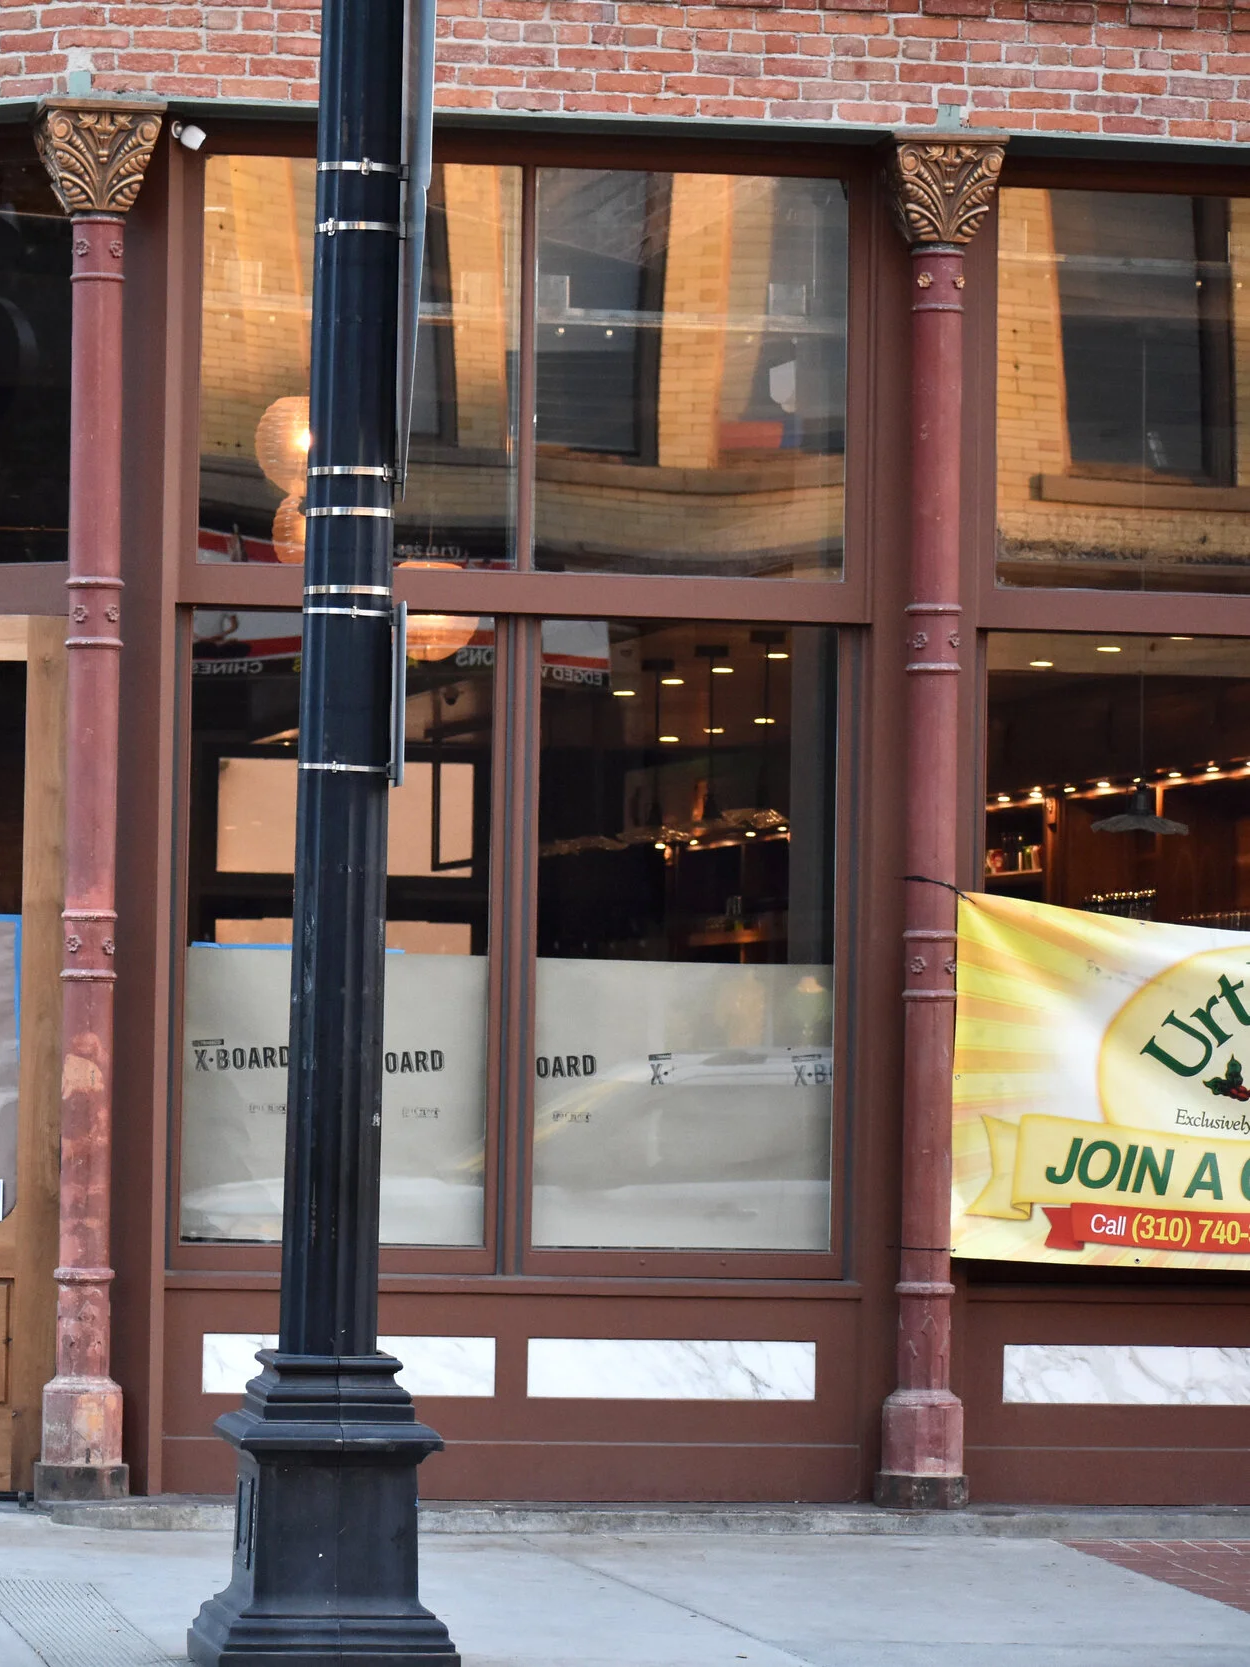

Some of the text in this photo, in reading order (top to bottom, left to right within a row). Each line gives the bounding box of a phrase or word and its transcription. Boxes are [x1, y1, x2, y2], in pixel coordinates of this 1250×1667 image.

[1139, 974, 1250, 1077] Urt
[1045, 1137, 1175, 1196] JOIN
[1183, 1152, 1224, 1201] A
[1090, 1212, 1250, 1248] Call (310) 740-
